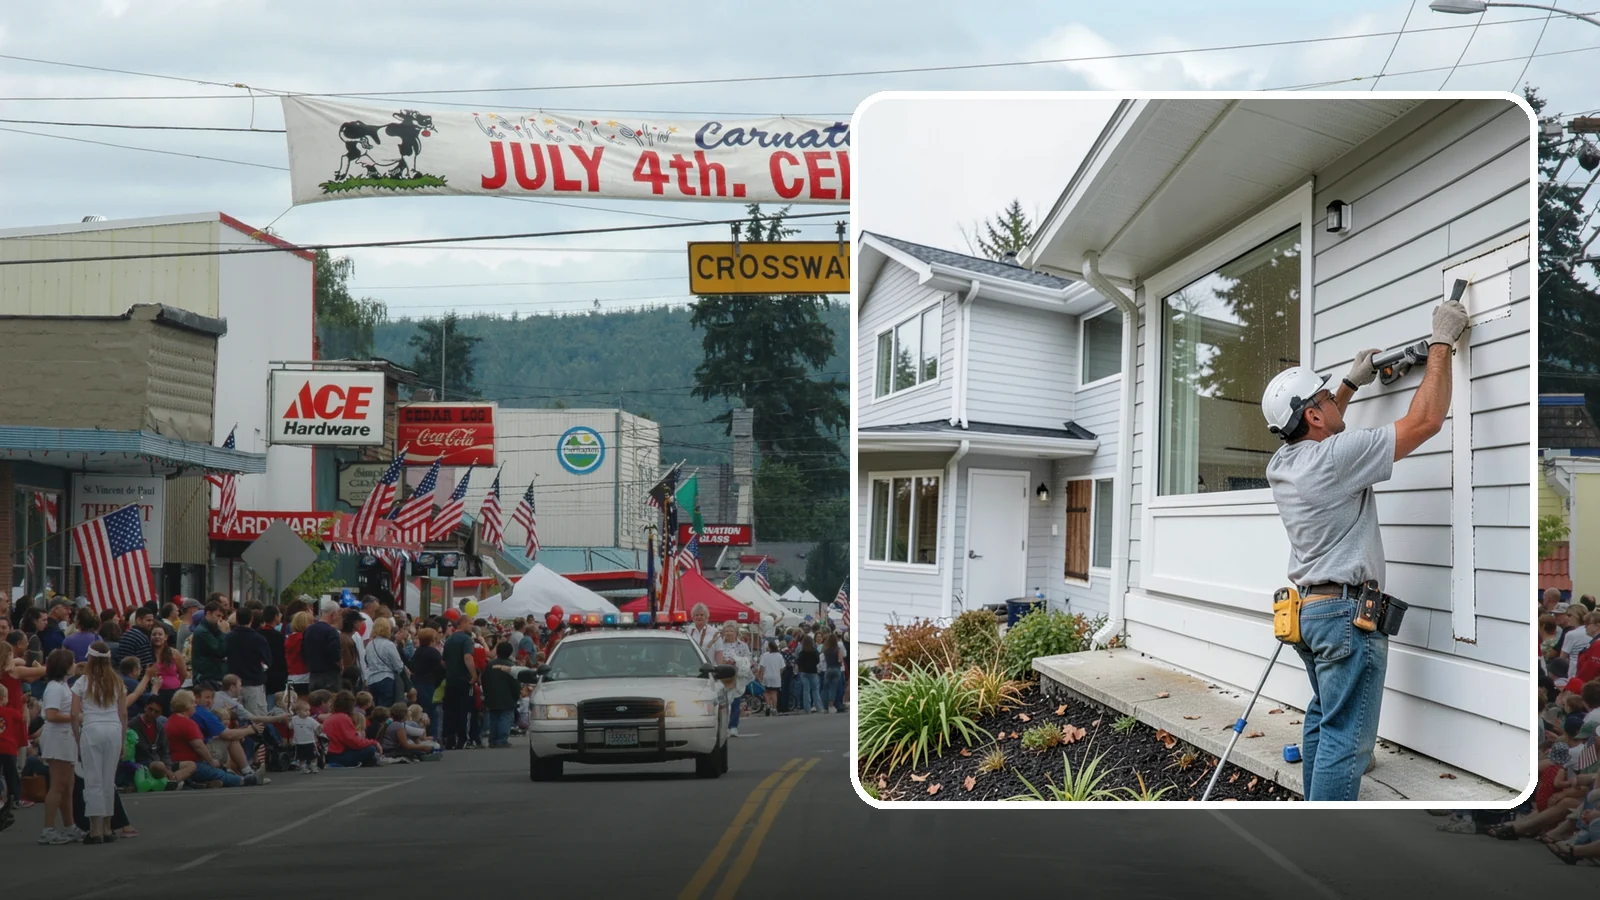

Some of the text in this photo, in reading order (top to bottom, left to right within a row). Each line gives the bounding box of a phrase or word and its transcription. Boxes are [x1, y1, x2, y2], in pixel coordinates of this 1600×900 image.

[481, 141, 605, 193] JULY
[632, 150, 746, 198] 4th.
[697, 254, 850, 280] CROSSWA
[283, 380, 373, 420] ACE
[406, 410, 484, 422] CEDAR LOG
[283, 421, 370, 436] Hardware
[416, 428, 476, 447] Coca-Cola
[353, 467, 385, 480] Simpl
[96, 485, 124, 494] Vincent
[126, 486, 136, 494] de
[138, 486, 155, 495] Paul
[212, 516, 330, 536] HARDARE
[688, 527, 741, 535] CRNATION
[699, 535, 730, 543] GLASS
